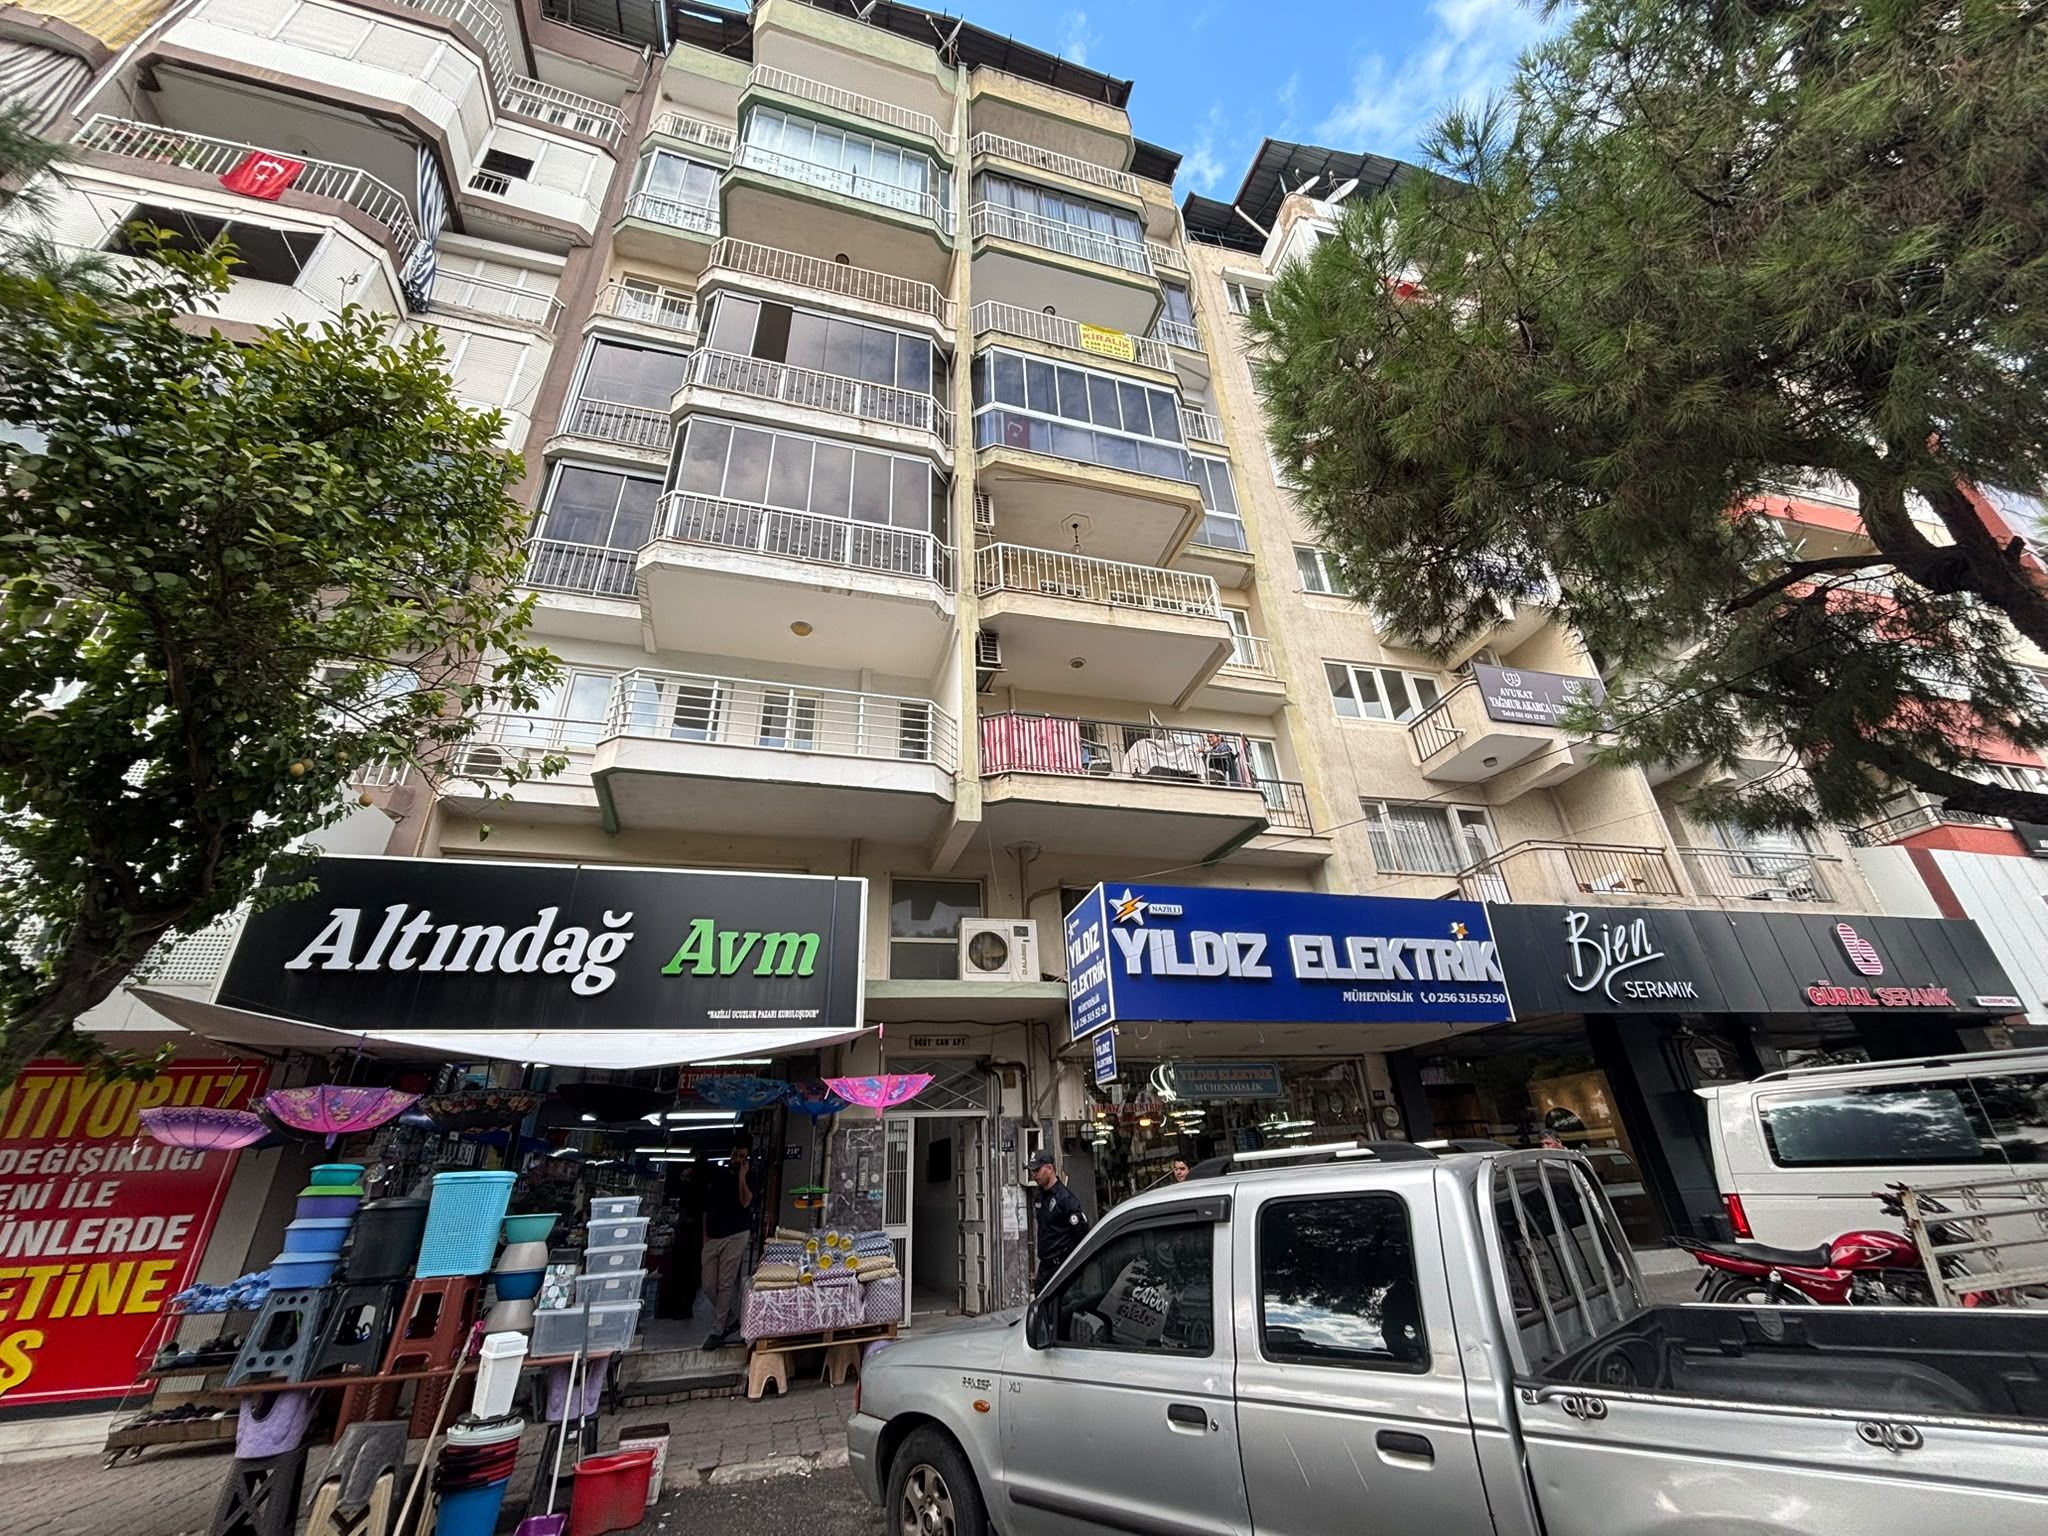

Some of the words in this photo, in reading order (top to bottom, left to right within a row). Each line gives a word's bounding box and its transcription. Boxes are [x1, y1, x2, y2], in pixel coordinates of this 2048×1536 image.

[1488, 696, 1522, 710] YAĞMUR
[1522, 699, 1552, 714] AKARCA
[1500, 687, 1534, 700] AVUKAT
[285, 903, 635, 996] Altındağ
[661, 918, 822, 977] Avm
[1069, 921, 1100, 970] YILDIZ
[1112, 928, 1273, 979] YILDIZ
[1566, 910, 1656, 992] Bien
[1072, 955, 1107, 1001] ELEKTRİK
[1807, 979, 1878, 1007] GÜRAL
[1343, 989, 1415, 1003] MÜHENDİSLİK
[1194, 1081, 1263, 1092] MÜHENDİSLİK
[59, 1175, 121, 1209] İLE
